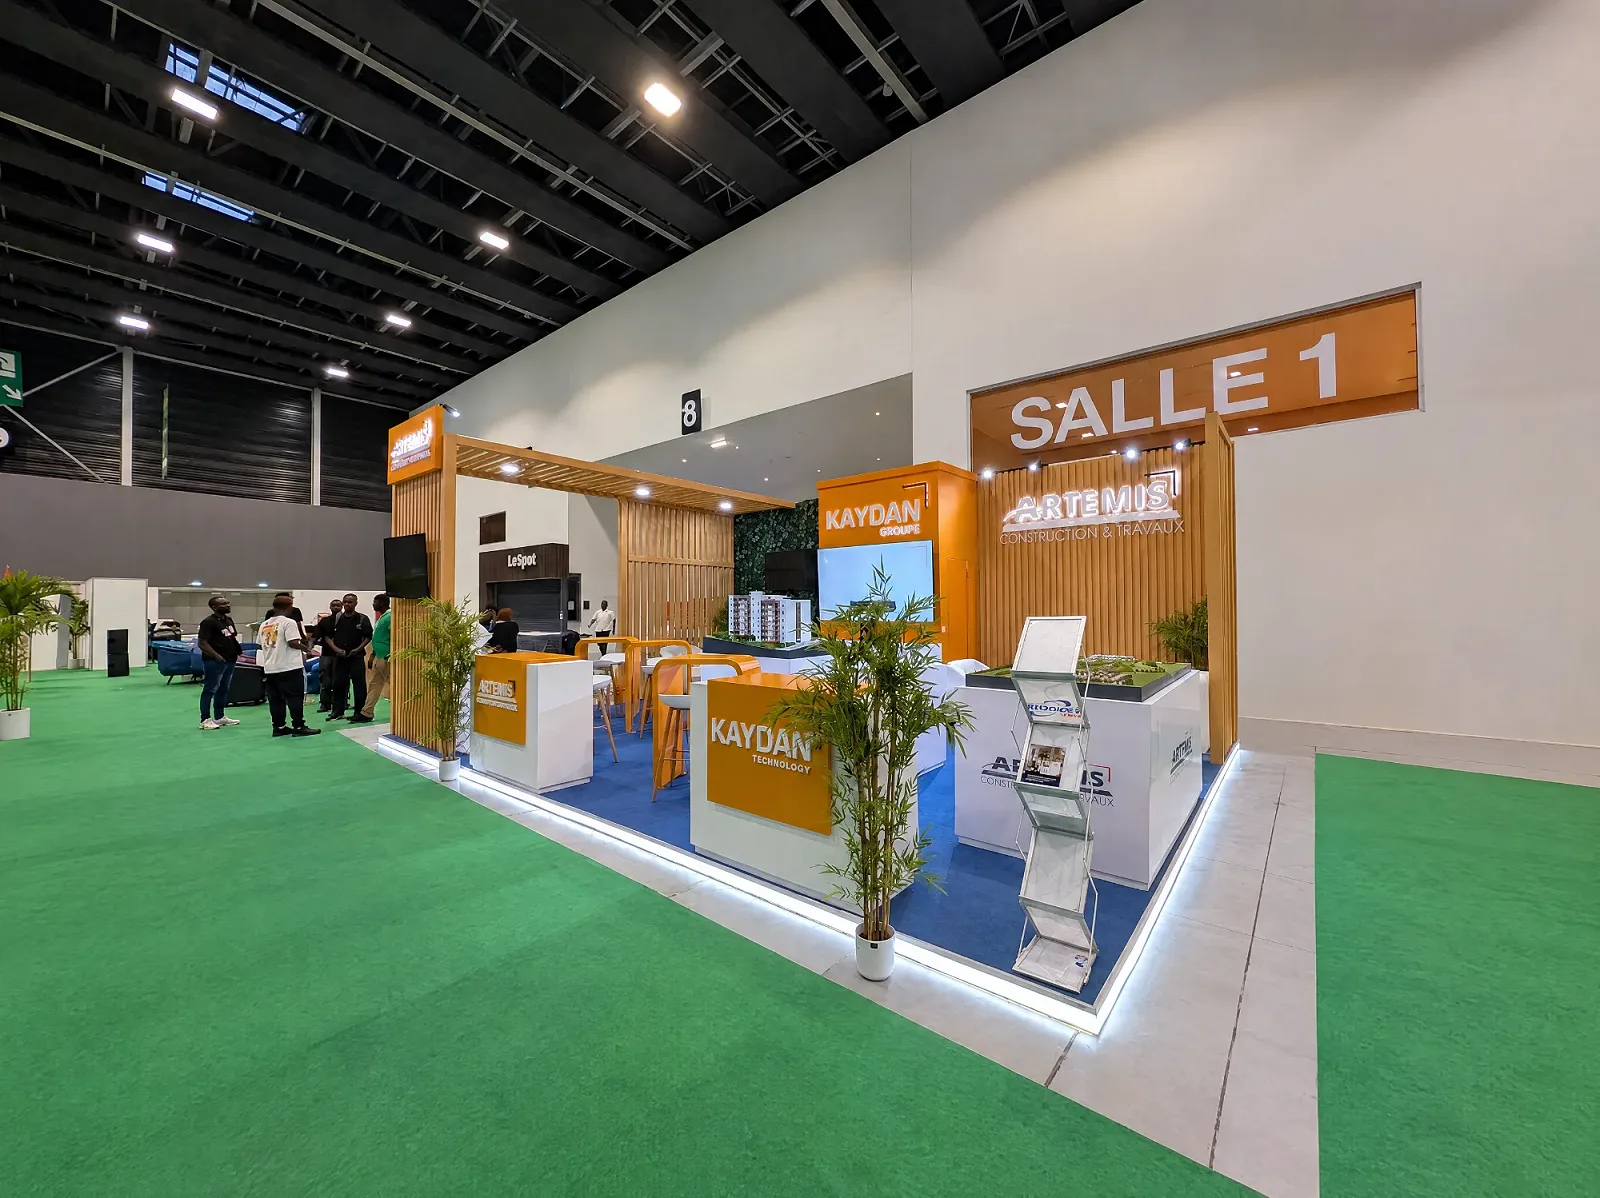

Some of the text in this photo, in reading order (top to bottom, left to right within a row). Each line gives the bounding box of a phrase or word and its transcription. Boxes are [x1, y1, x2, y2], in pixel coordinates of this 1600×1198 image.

[1010, 332, 1336, 450] SALLE 1
[683, 400, 697, 427] 8
[825, 499, 920, 530] KAYDAN
[1003, 480, 1169, 523] ARTEMIS
[879, 524, 920, 537] GROUPE
[1000, 520, 1185, 545] CONSTRUCTION & TRAVAUX
[507, 553, 537, 570] LeSpot
[478, 680, 513, 698] ARTEMIS
[711, 717, 812, 762] KAYDAN
[752, 754, 811, 774] TECHNOLOGY
